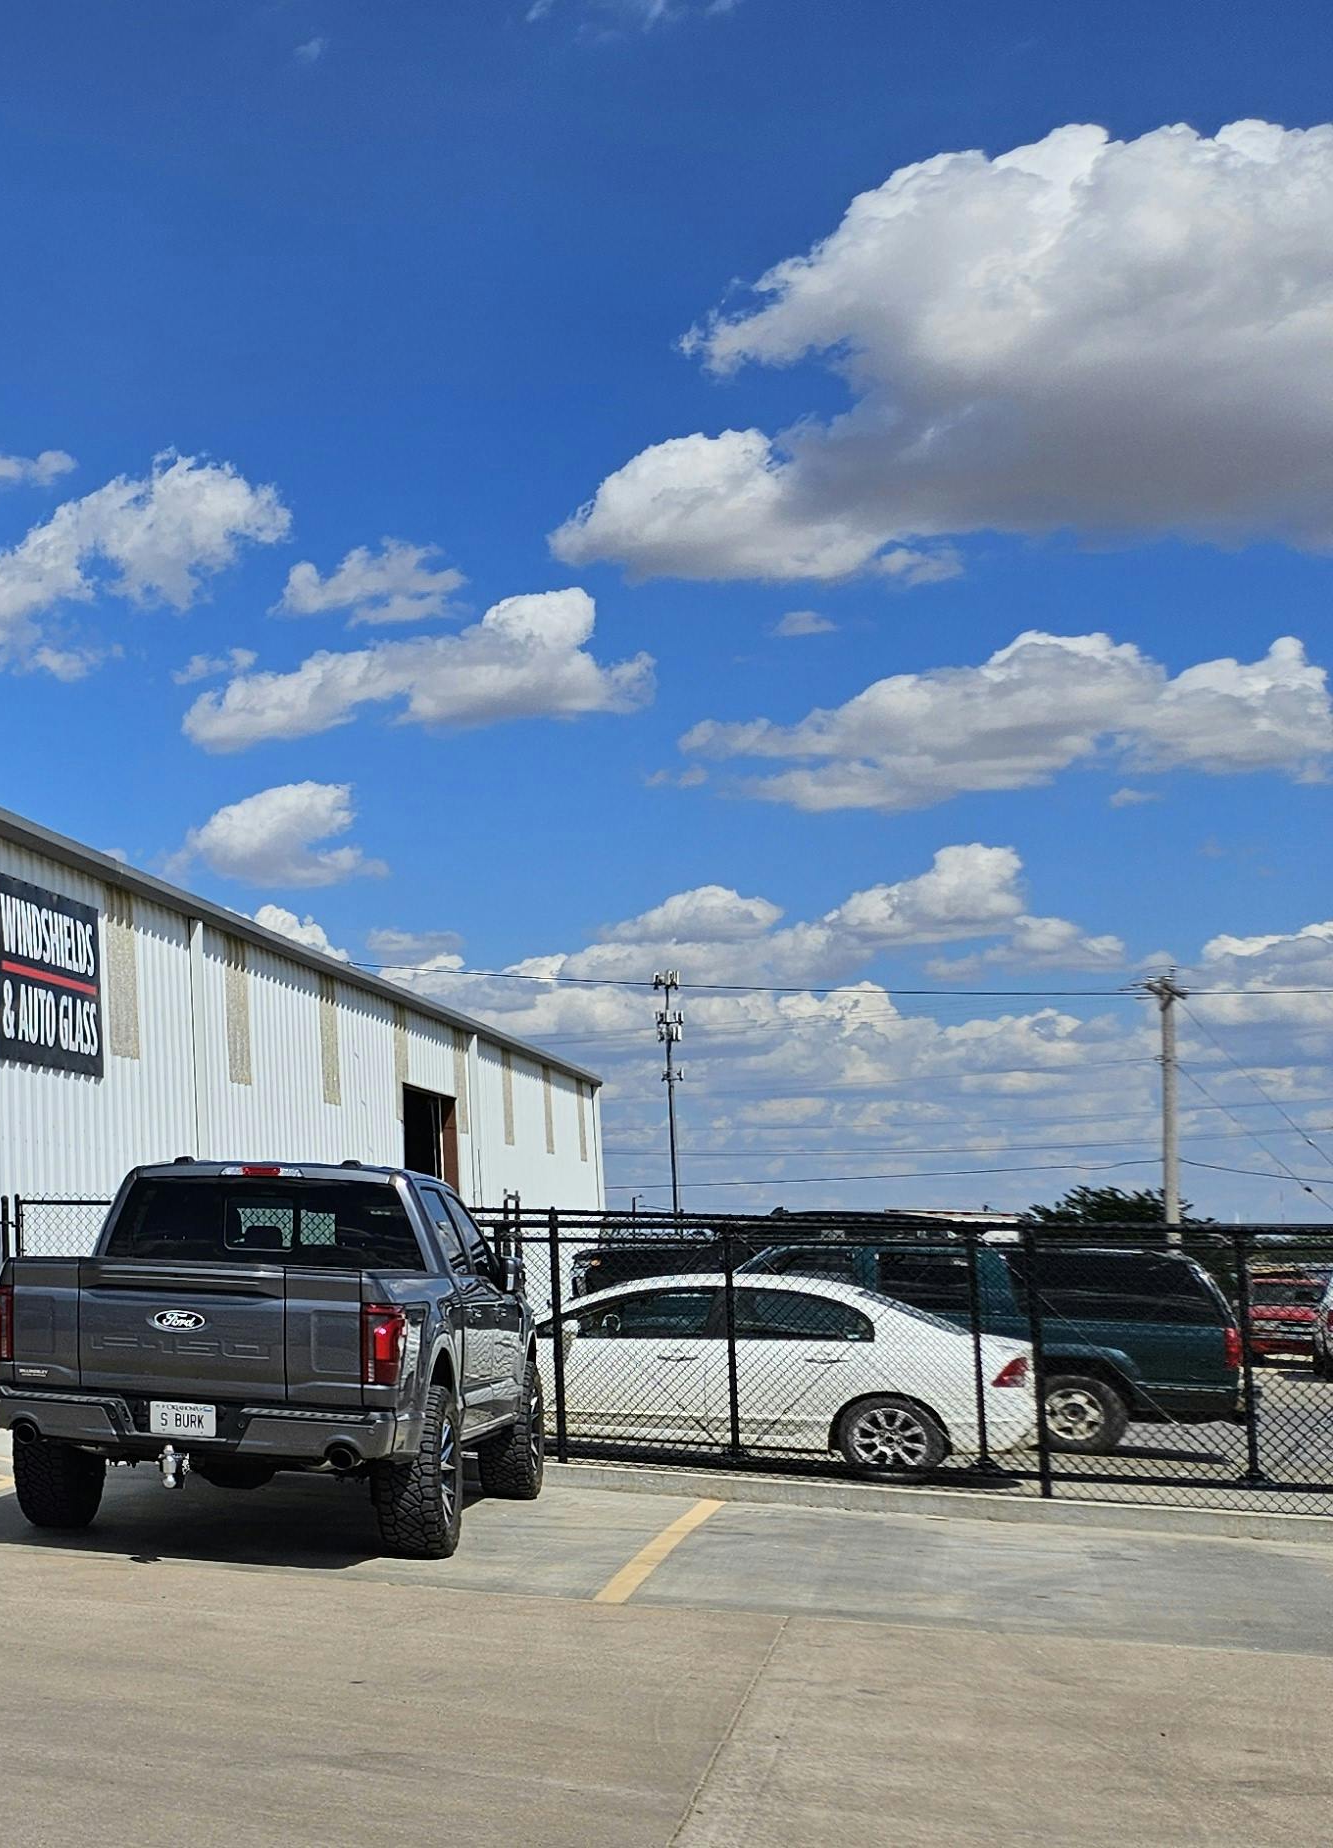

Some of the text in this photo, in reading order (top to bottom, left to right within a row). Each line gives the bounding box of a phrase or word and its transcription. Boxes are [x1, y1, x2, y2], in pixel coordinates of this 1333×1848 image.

[0, 893, 95, 978] WINDSHIELDS
[2, 979, 99, 1057] & AUTO GLASS
[162, 1312, 195, 1328] Ford
[160, 1412, 205, 1429] S BURK
